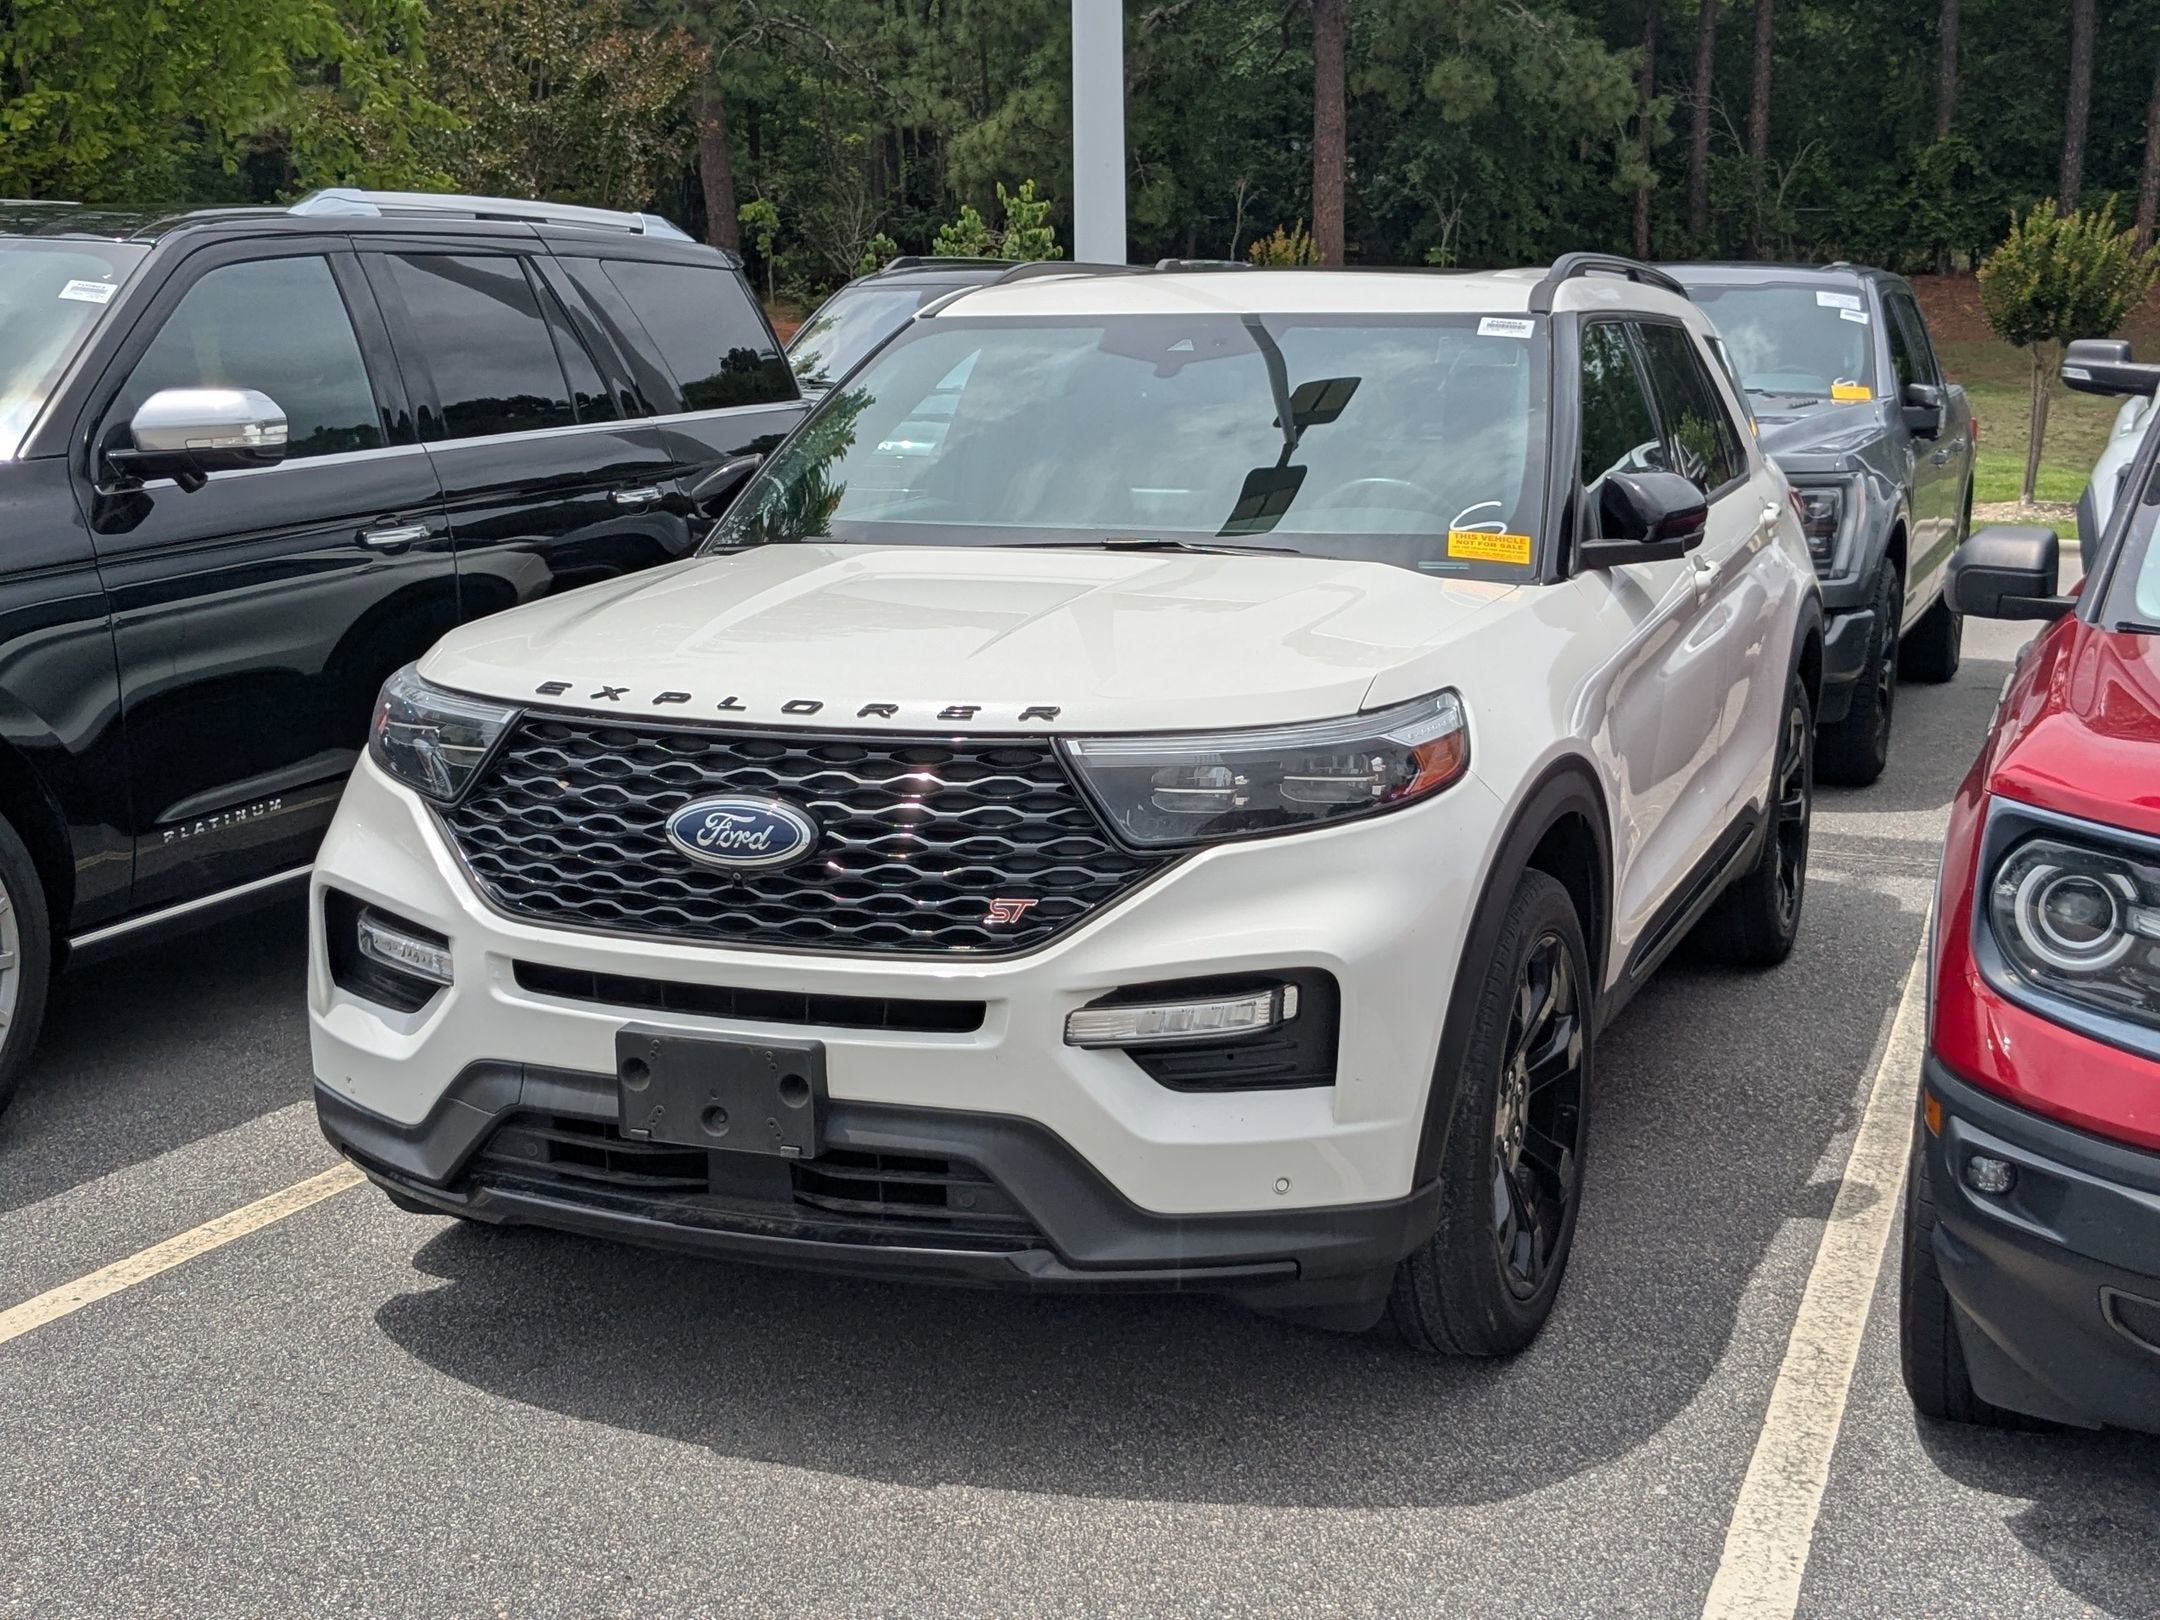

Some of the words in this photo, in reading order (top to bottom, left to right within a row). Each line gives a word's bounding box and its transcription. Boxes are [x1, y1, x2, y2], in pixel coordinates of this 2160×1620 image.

[1455, 533, 1478, 541] THIS
[1481, 535, 1526, 544] VEHICLE
[536, 681, 1061, 721] EXPLORER
[163, 798, 281, 843] PLATINUM
[696, 812, 775, 851] Ford
[984, 898, 1039, 923] ST
